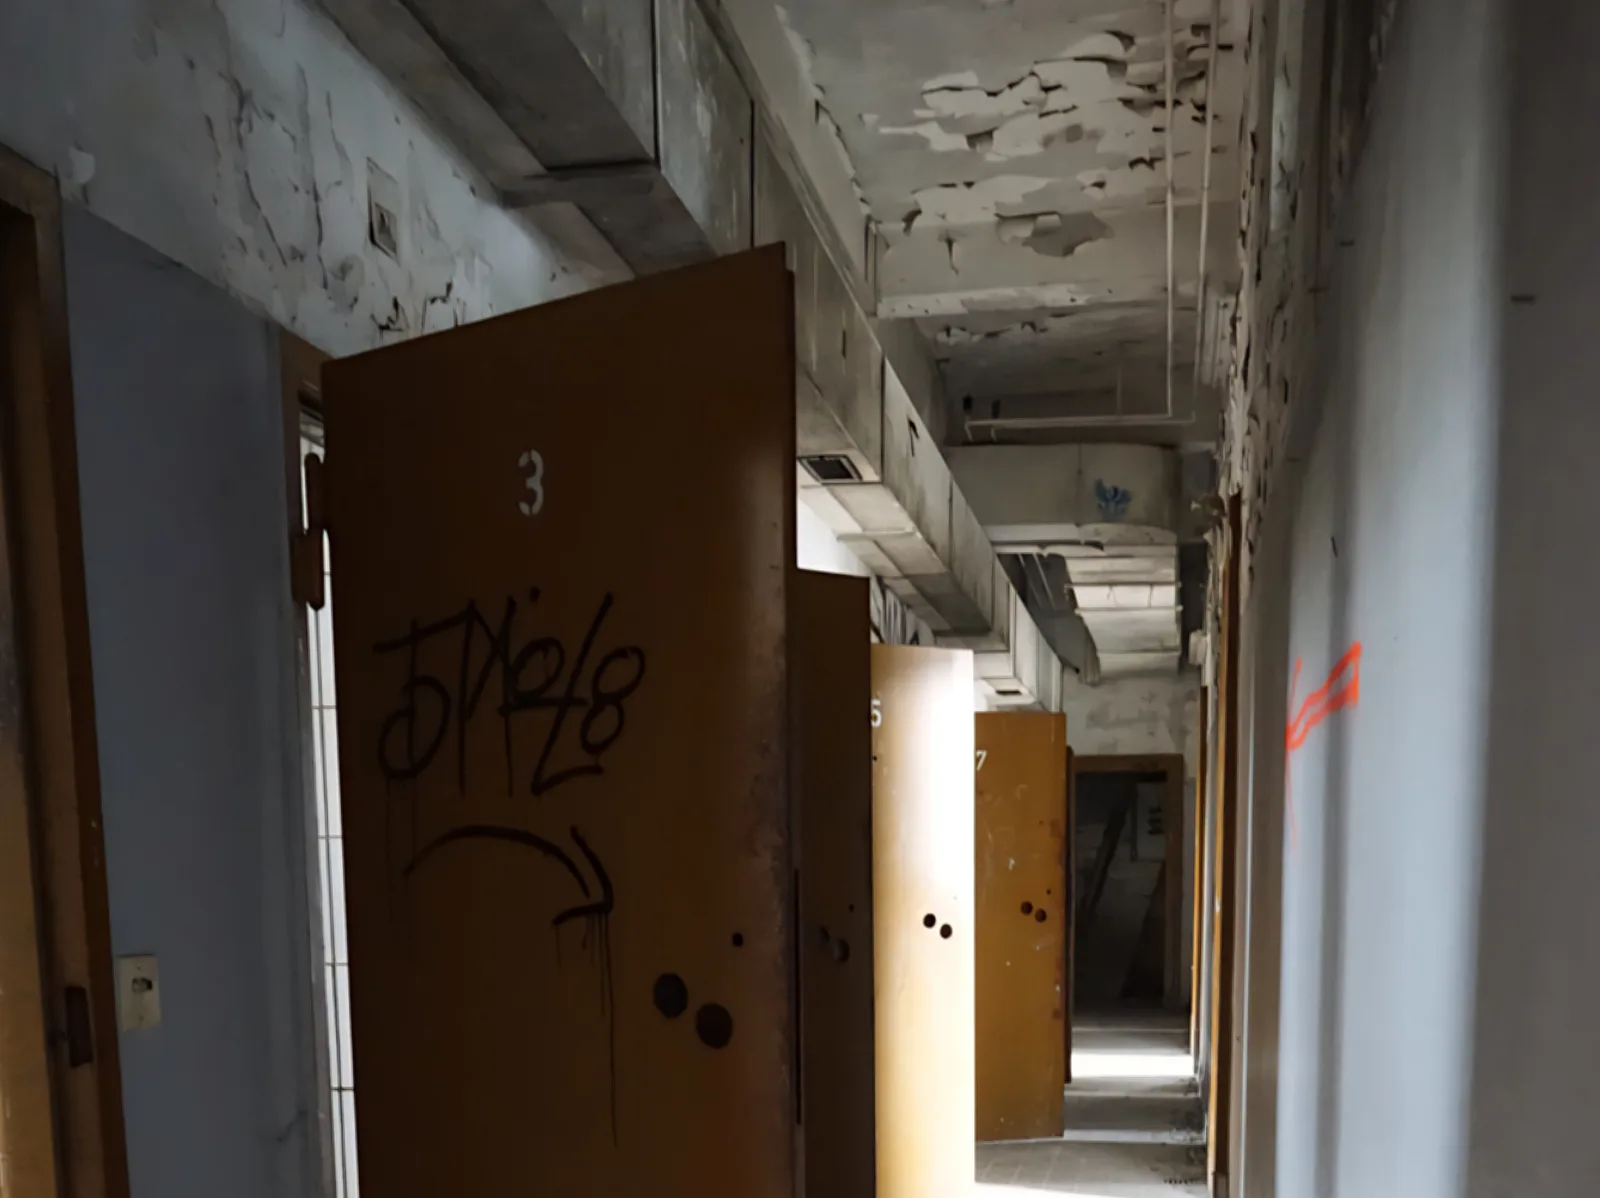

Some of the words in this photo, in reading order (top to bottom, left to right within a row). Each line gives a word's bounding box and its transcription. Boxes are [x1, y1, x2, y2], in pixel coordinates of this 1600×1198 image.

[518, 448, 544, 516] 3
[871, 698, 882, 728] 5
[976, 749, 987, 771] 7
